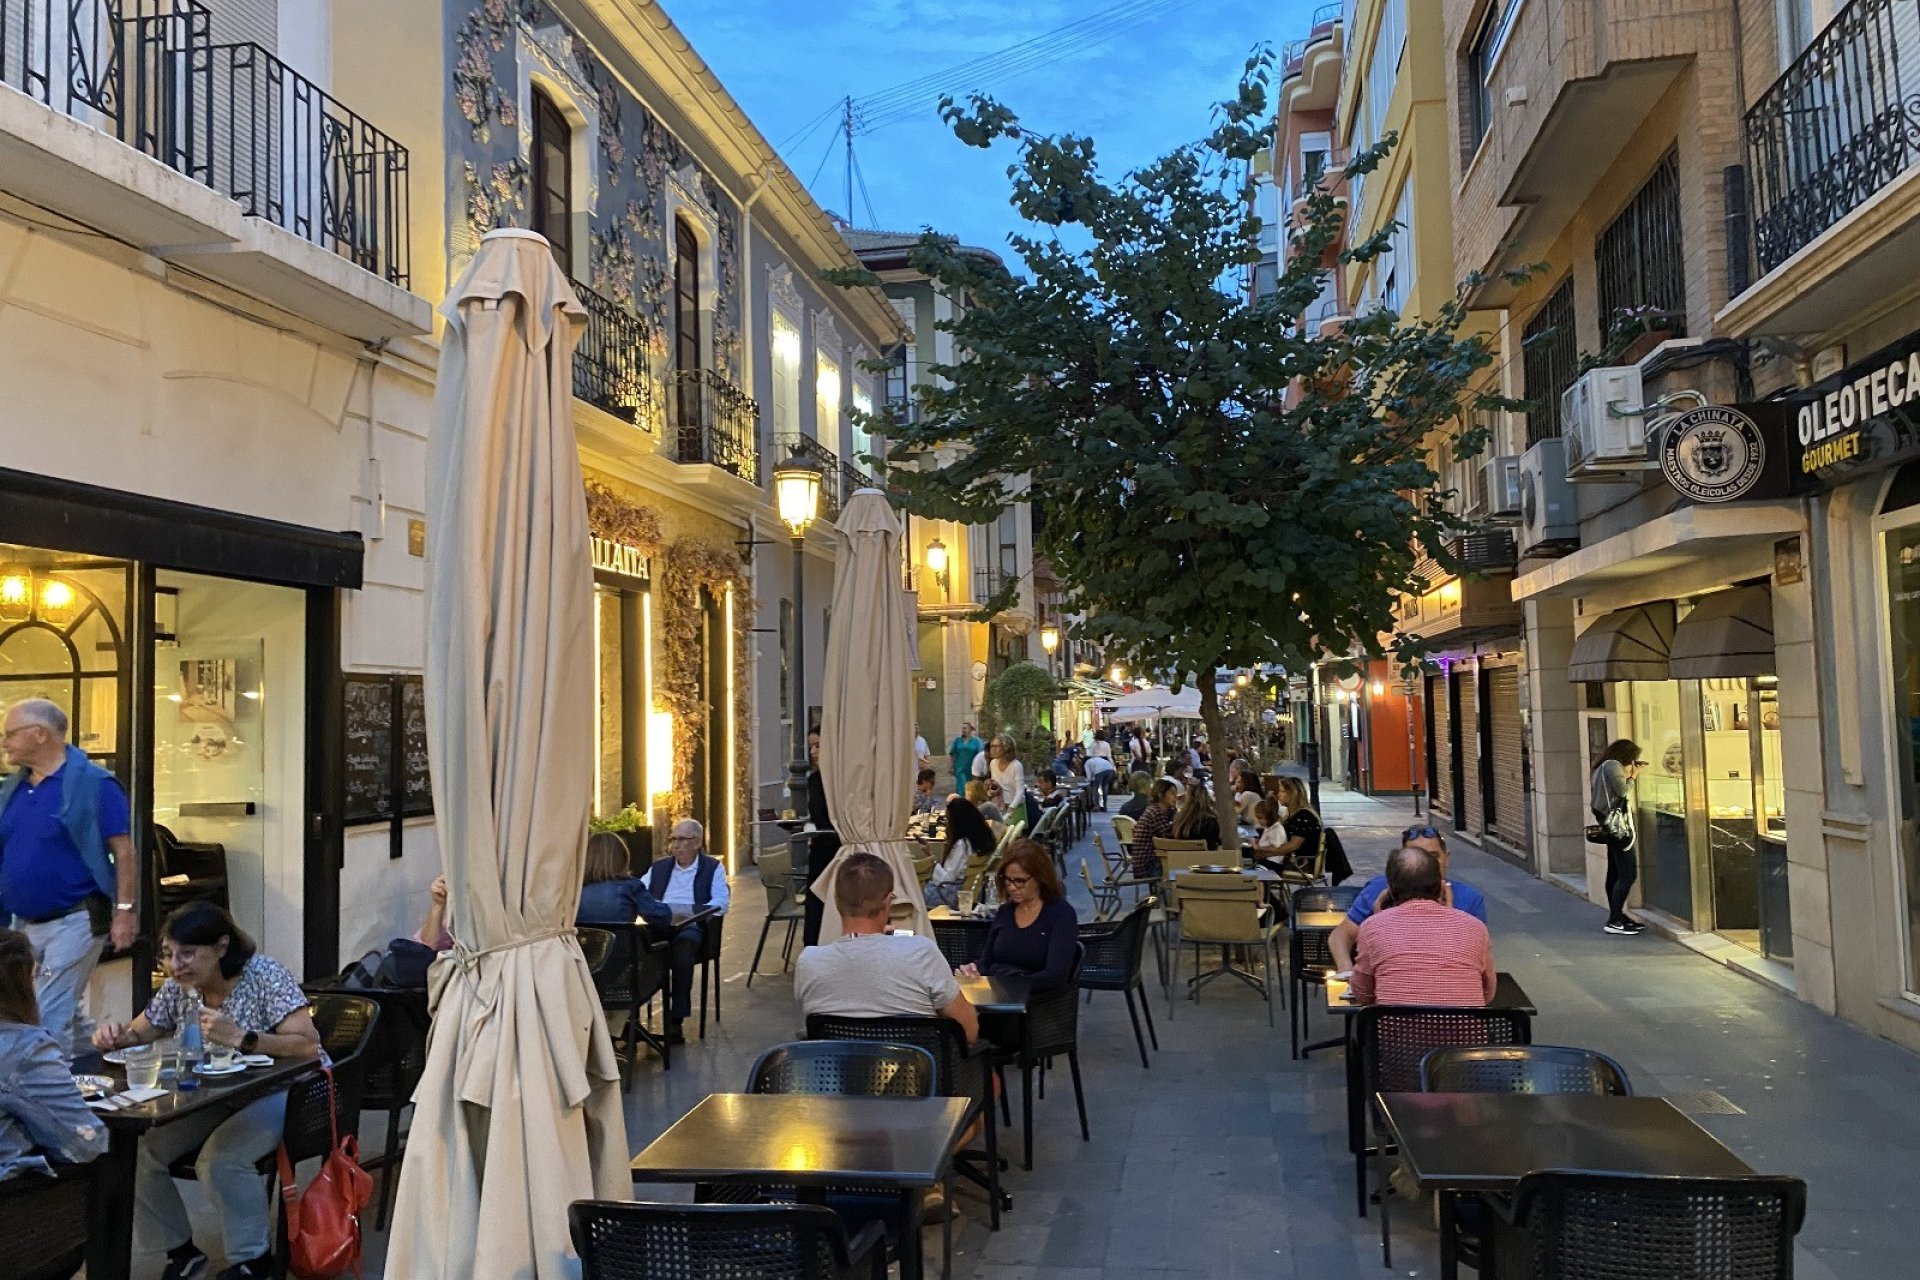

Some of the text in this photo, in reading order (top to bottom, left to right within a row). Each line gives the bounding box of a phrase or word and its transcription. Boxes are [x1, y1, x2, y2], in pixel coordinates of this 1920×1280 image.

[1798, 352, 1920, 446] OLEOTECA
[1673, 410, 1745, 437] LA CHINATA
[1802, 431, 1860, 474] GOURMET
